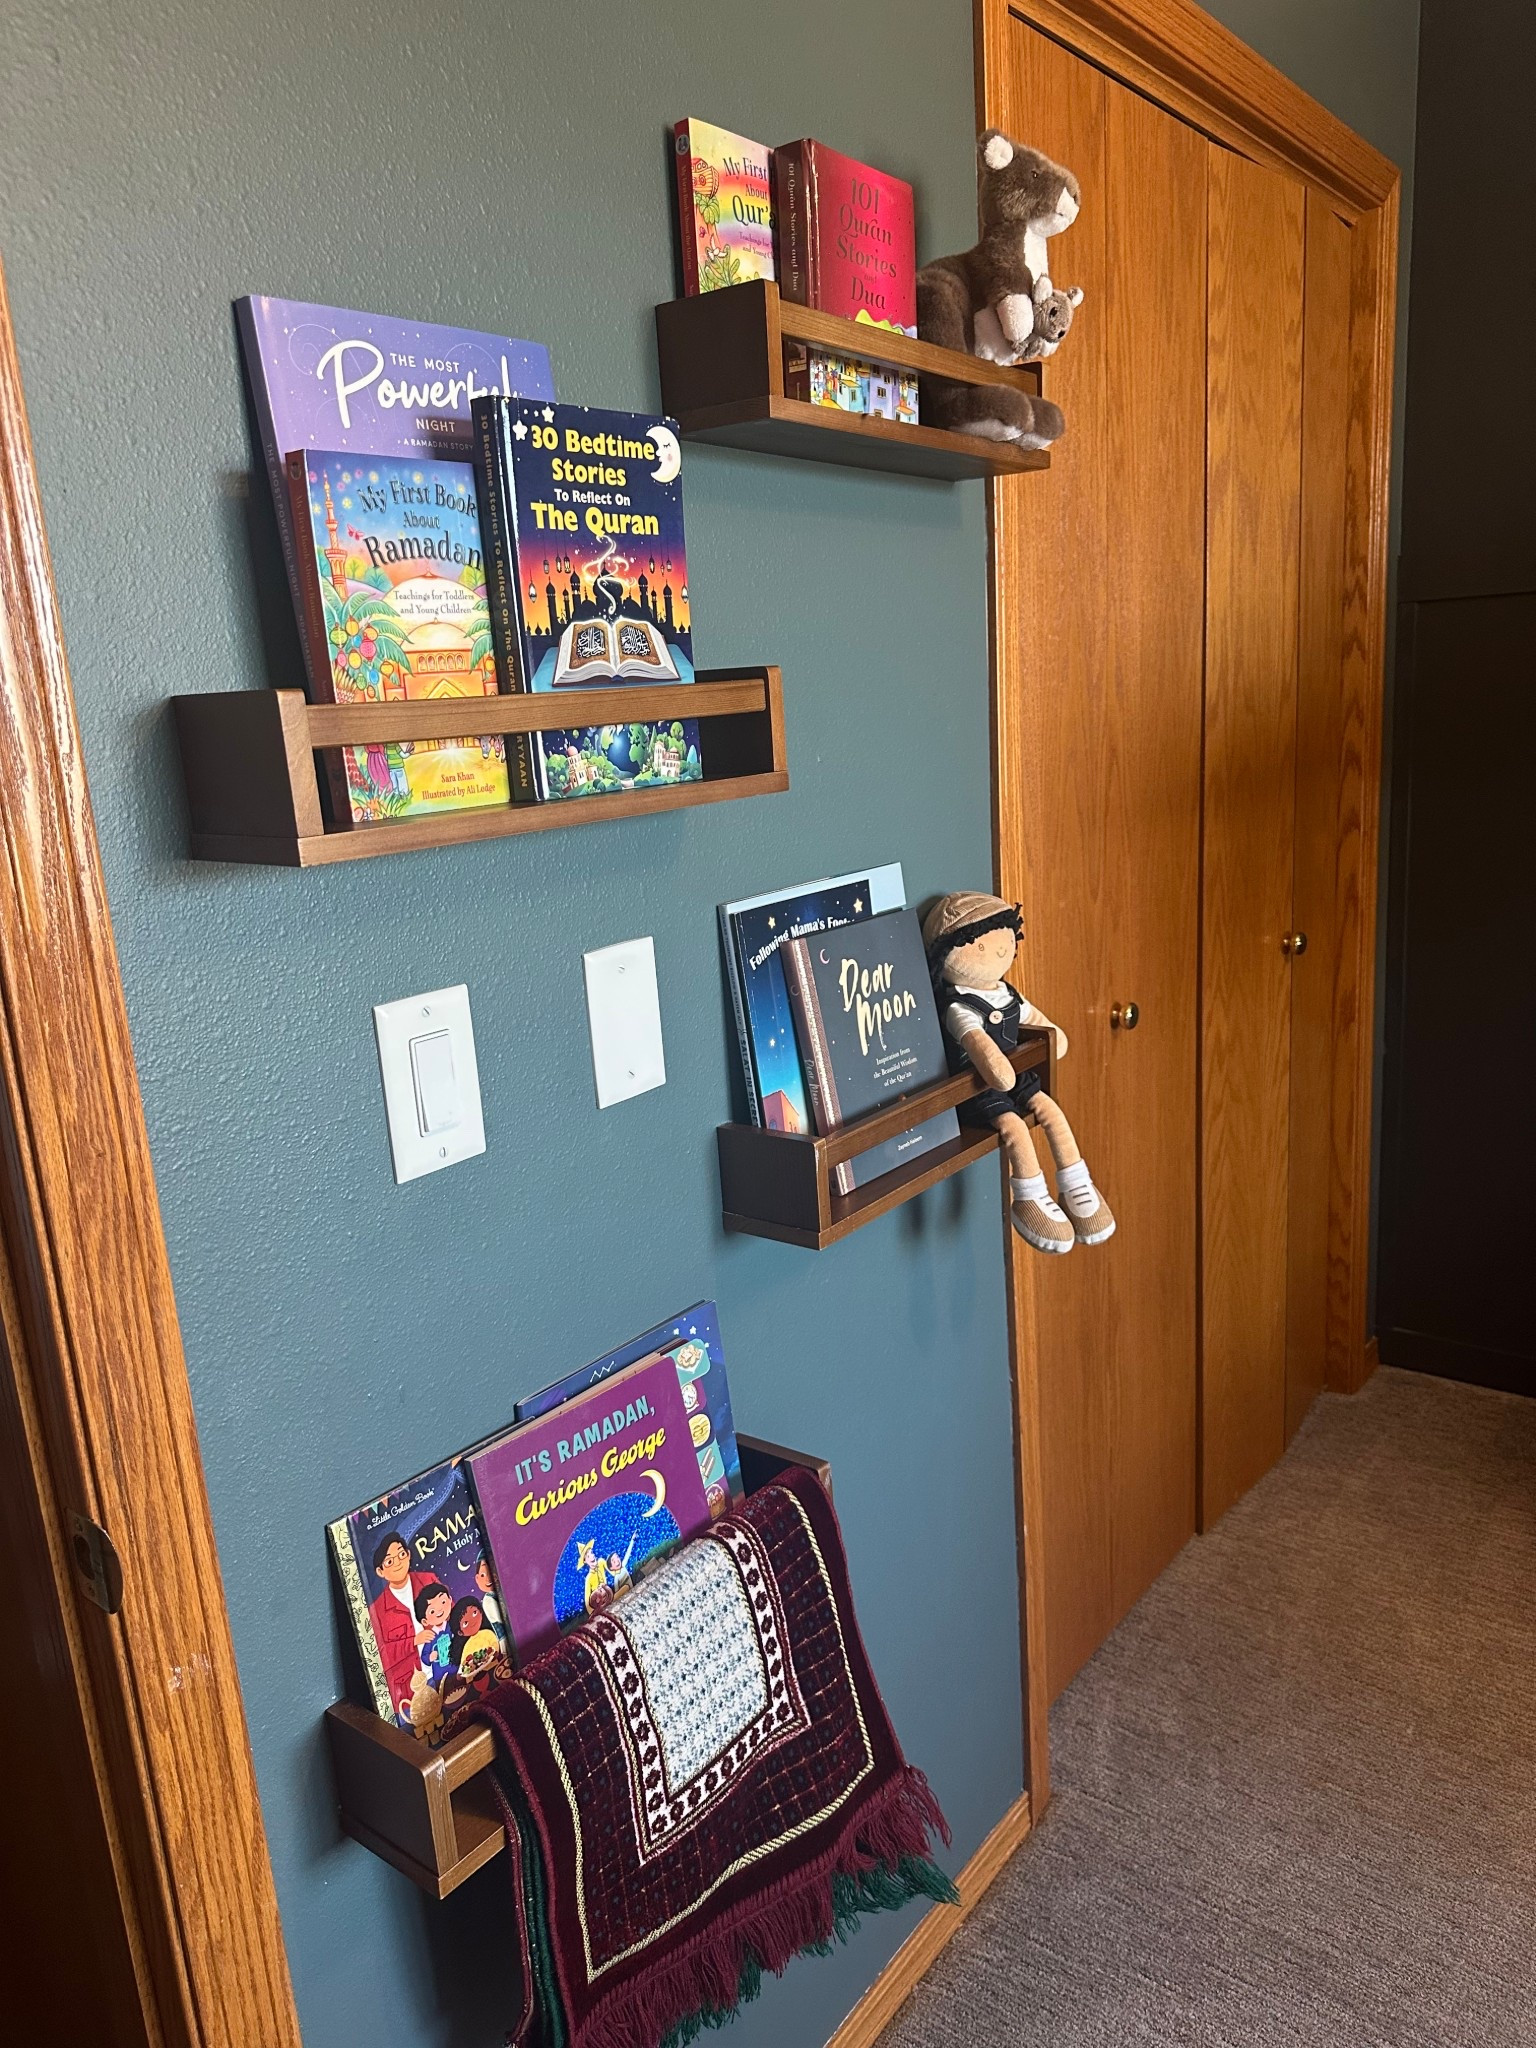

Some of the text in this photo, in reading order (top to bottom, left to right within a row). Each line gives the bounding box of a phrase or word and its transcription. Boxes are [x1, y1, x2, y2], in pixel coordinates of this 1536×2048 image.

[723, 157, 740, 180] My
[743, 157, 768, 182] First
[787, 163, 795, 176] 101
[745, 184, 768, 201] About
[852, 178, 879, 214] 101
[732, 195, 776, 229] Qur'a
[790, 212, 798, 247] Stories
[743, 245, 752, 253] and
[752, 247, 767, 259] Young
[790, 250, 798, 268] and
[837, 234, 897, 278] Stories
[864, 273, 877, 283] and
[851, 276, 886, 310] Dua
[390, 352, 460, 374] THE MOST
[416, 418, 456, 433] NIGHT
[481, 415, 488, 430] 30
[403, 437, 474, 452] A RAMADAN STORY
[531, 425, 655, 461] 30 Bedtime
[483, 435, 493, 487] Bedtime
[552, 458, 627, 487] Stories
[357, 479, 477, 518] My First Book
[554, 488, 631, 506] To Reflect On
[403, 510, 440, 529] About
[489, 491, 499, 536] Stories
[530, 502, 659, 538] The Quran
[363, 530, 482, 571] Ramadan
[495, 539, 502, 556] To
[393, 589, 474, 601] Teachings for Toddlers
[497, 561, 507, 604] Reflect
[401, 604, 471, 615] and Young Children
[502, 609, 509, 625] On
[507, 655, 516, 692] Quran
[516, 735, 528, 787] RYYAAN
[422, 783, 495, 800] Illustrated by Ali Lodge
[441, 772, 475, 783] Sara Khan
[749, 929, 790, 971] Following
[790, 918, 825, 939] Mama's
[839, 958, 894, 1013] Dear
[856, 990, 917, 1057] Moon
[740, 1040, 751, 1072] SALAT
[746, 1076, 752, 1088] IN
[899, 1047, 911, 1056] from
[873, 1071, 882, 1079] the
[900, 1057, 918, 1072] Wisdom
[884, 1079, 890, 1087] of
[889, 1077, 897, 1085] the
[514, 1395, 655, 1486] IT'S RAMADAN,
[515, 1427, 666, 1526] Curious George
[366, 1523, 374, 1531] a
[372, 1513, 391, 1527] Little
[390, 1500, 417, 1517] Golden
[415, 1504, 476, 1560] RAMA
[446, 1546, 454, 1557] A
[453, 1533, 474, 1551] Holy
